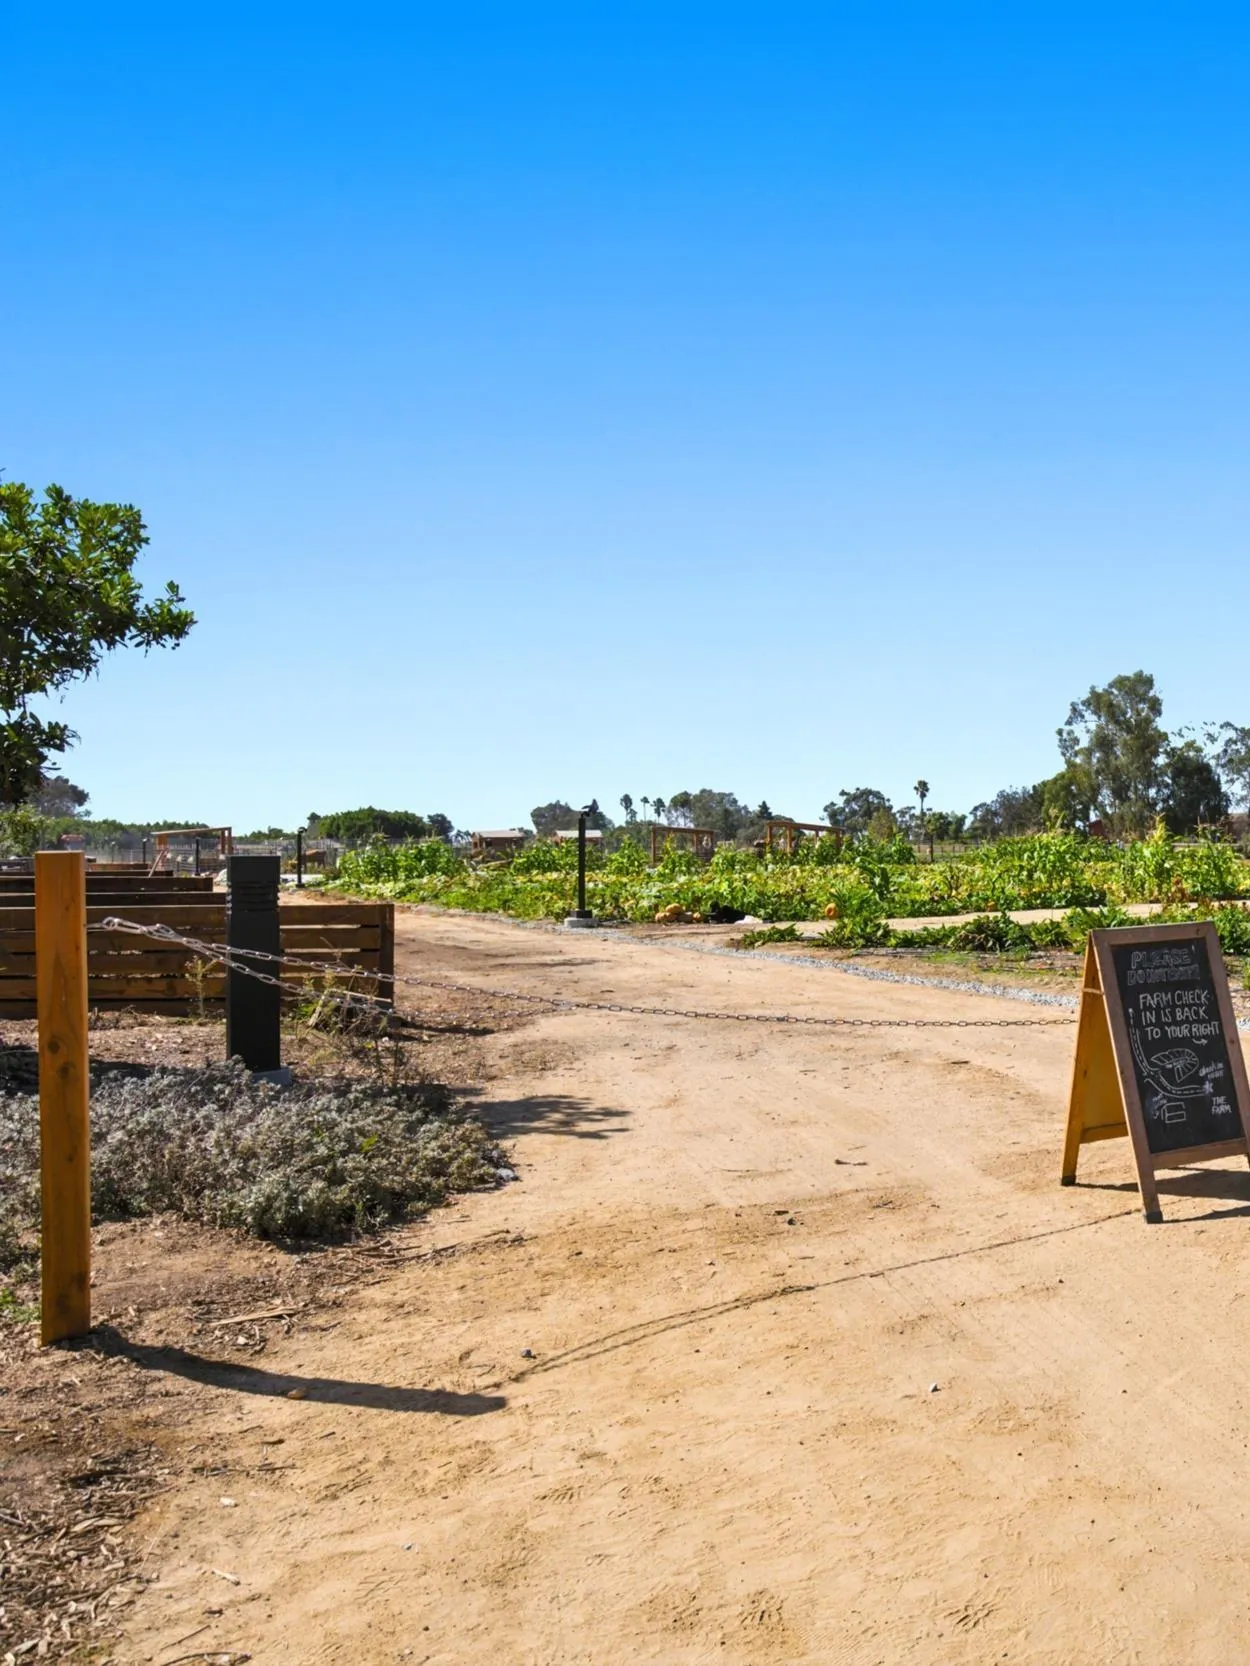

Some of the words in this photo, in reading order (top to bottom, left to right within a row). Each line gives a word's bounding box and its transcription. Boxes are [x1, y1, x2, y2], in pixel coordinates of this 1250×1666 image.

[1140, 991, 1172, 1009] FARM
[1141, 1010, 1156, 1025] IN
[1161, 1008, 1172, 1022] IS
[1175, 1006, 1208, 1021] BACK
[1145, 1026, 1161, 1040] TO
[1165, 1024, 1191, 1039] YOUR
[1192, 1021, 1220, 1036] RIGHT
